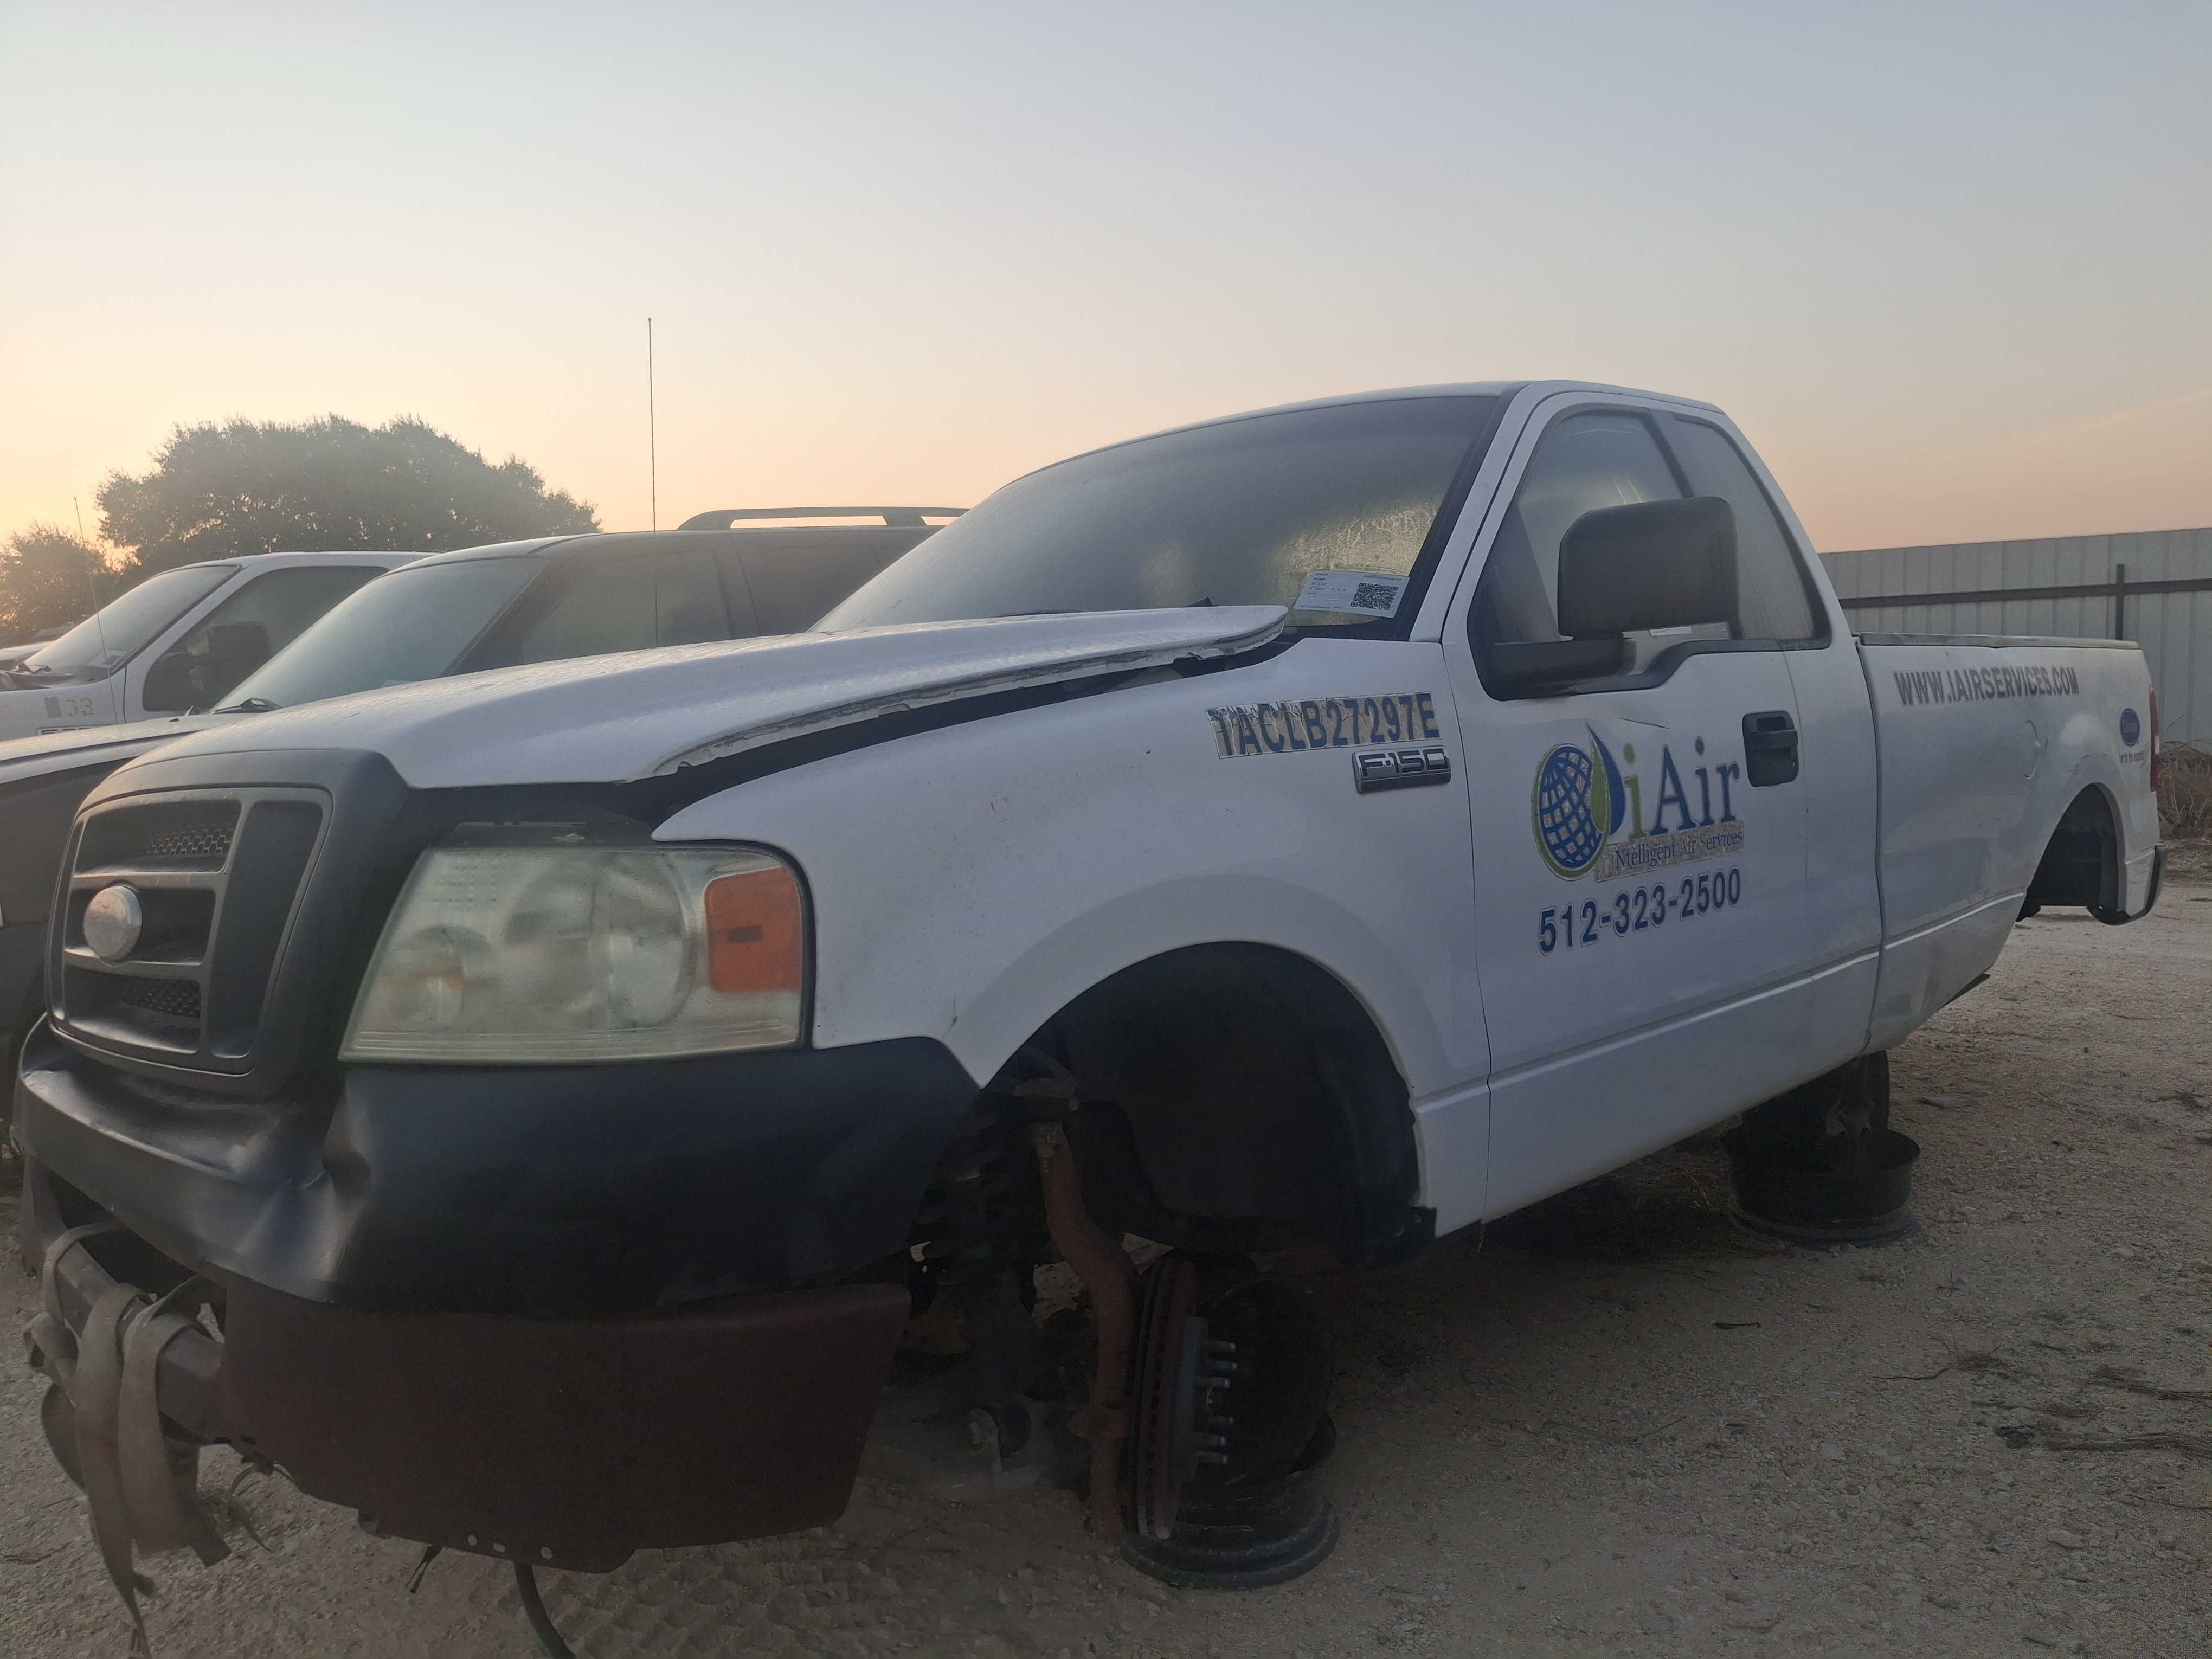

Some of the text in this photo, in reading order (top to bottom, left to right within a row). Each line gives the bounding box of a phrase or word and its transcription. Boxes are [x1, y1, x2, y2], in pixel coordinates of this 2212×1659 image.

[1893, 666, 2080, 707] WWW.IAIRSERVICES.COM
[1680, 838, 1697, 856] Air
[1700, 829, 1742, 852] Services
[1539, 867, 1741, 953] 512-323-2500
